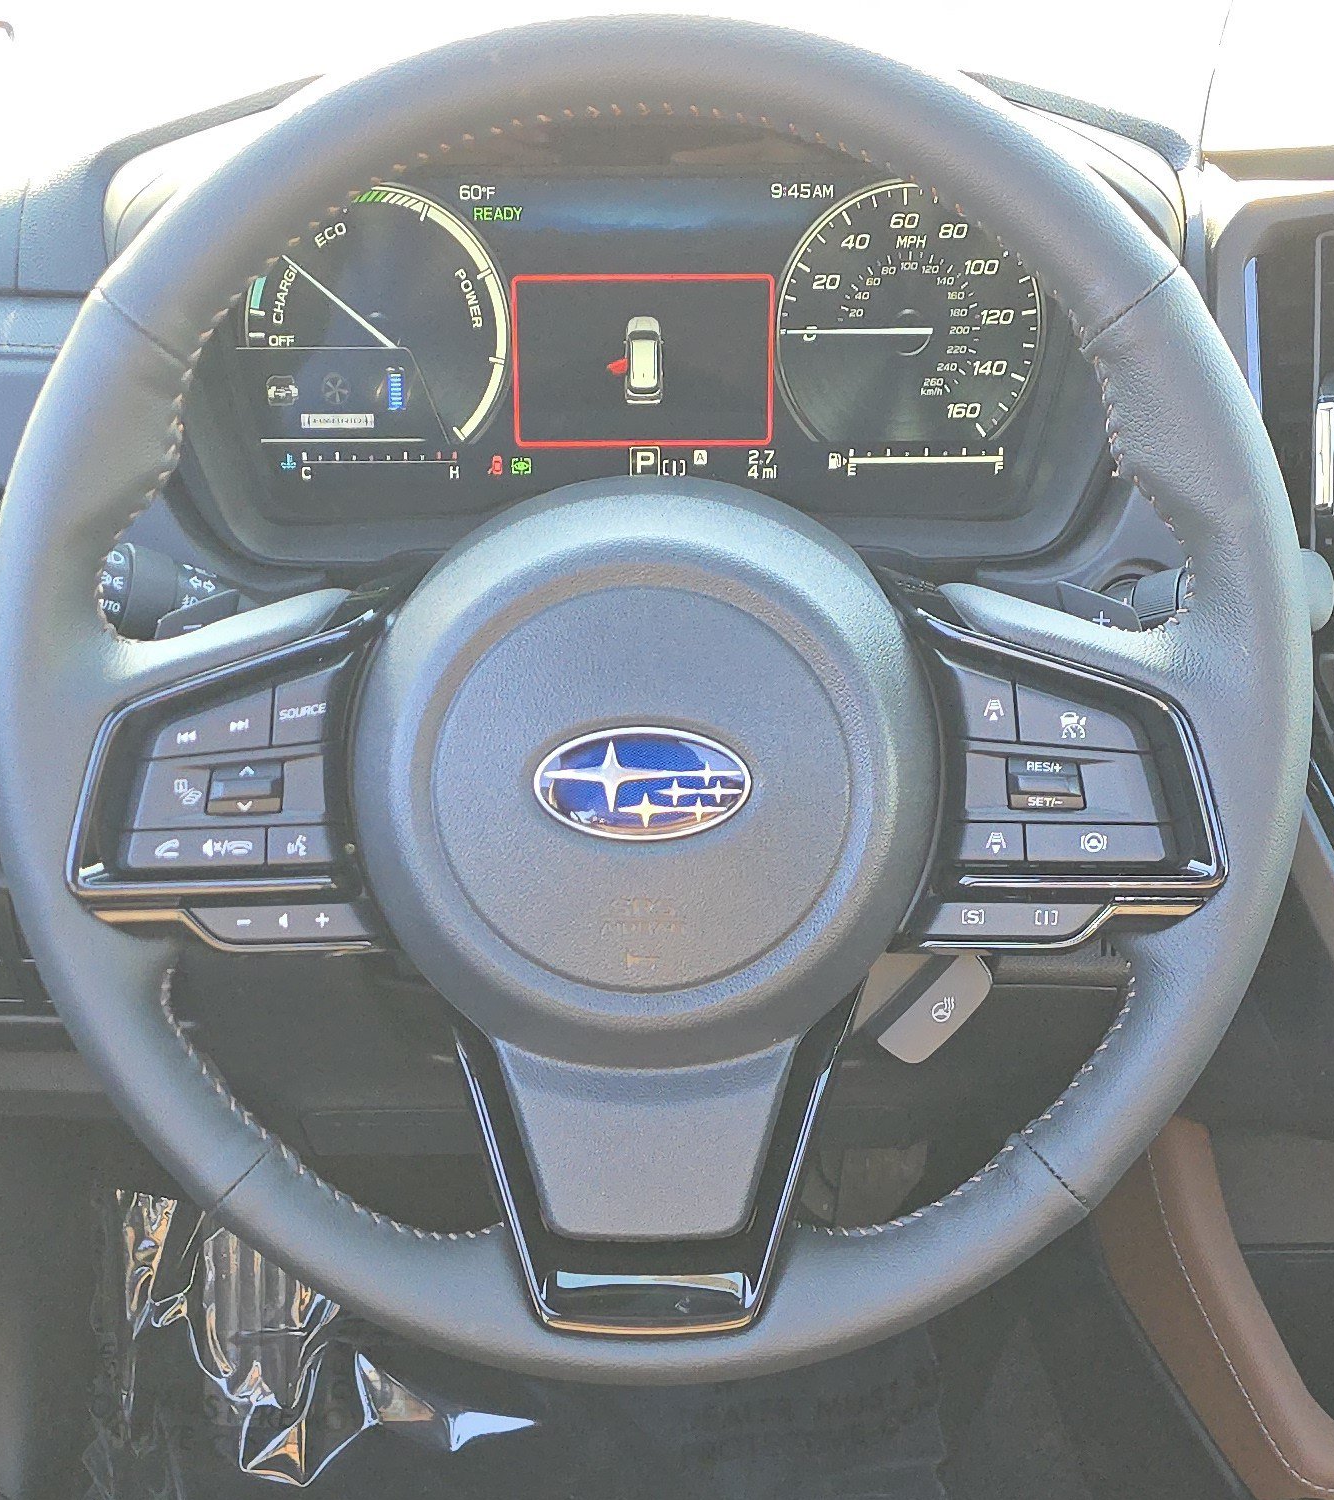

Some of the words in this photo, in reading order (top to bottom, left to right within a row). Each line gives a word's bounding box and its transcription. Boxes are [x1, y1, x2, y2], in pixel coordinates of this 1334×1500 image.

[473, 207, 523, 221] READY
[890, 213, 920, 229] 60
[314, 222, 347, 248] ECO
[938, 223, 968, 239] 80
[840, 234, 871, 249] 40
[895, 235, 927, 249] MPH
[900, 262, 919, 271] 100
[921, 265, 940, 274] 120
[964, 259, 1000, 275] 100
[812, 274, 841, 290] 20
[866, 277, 881, 286] 60
[936, 276, 955, 286] 140
[454, 268, 483, 329] POWER
[854, 292, 870, 300] 40
[848, 308, 864, 317] 20
[980, 309, 1015, 325] 120
[949, 326, 971, 335] 200
[268, 335, 295, 347] OFF
[946, 345, 968, 354] 220
[936, 362, 958, 372] 240
[973, 360, 1008, 376] 140
[923, 377, 944, 387] 260
[920, 387, 943, 396] km/h
[946, 402, 982, 419] 160
[636, 451, 655, 474] P
[847, 463, 858, 477] E
[994, 461, 1005, 476] F
[301, 465, 313, 480] C
[449, 465, 461, 480] H
[747, 465, 759, 480] 4
[762, 465, 777, 480] mi
[278, 701, 327, 721] SOURCE
